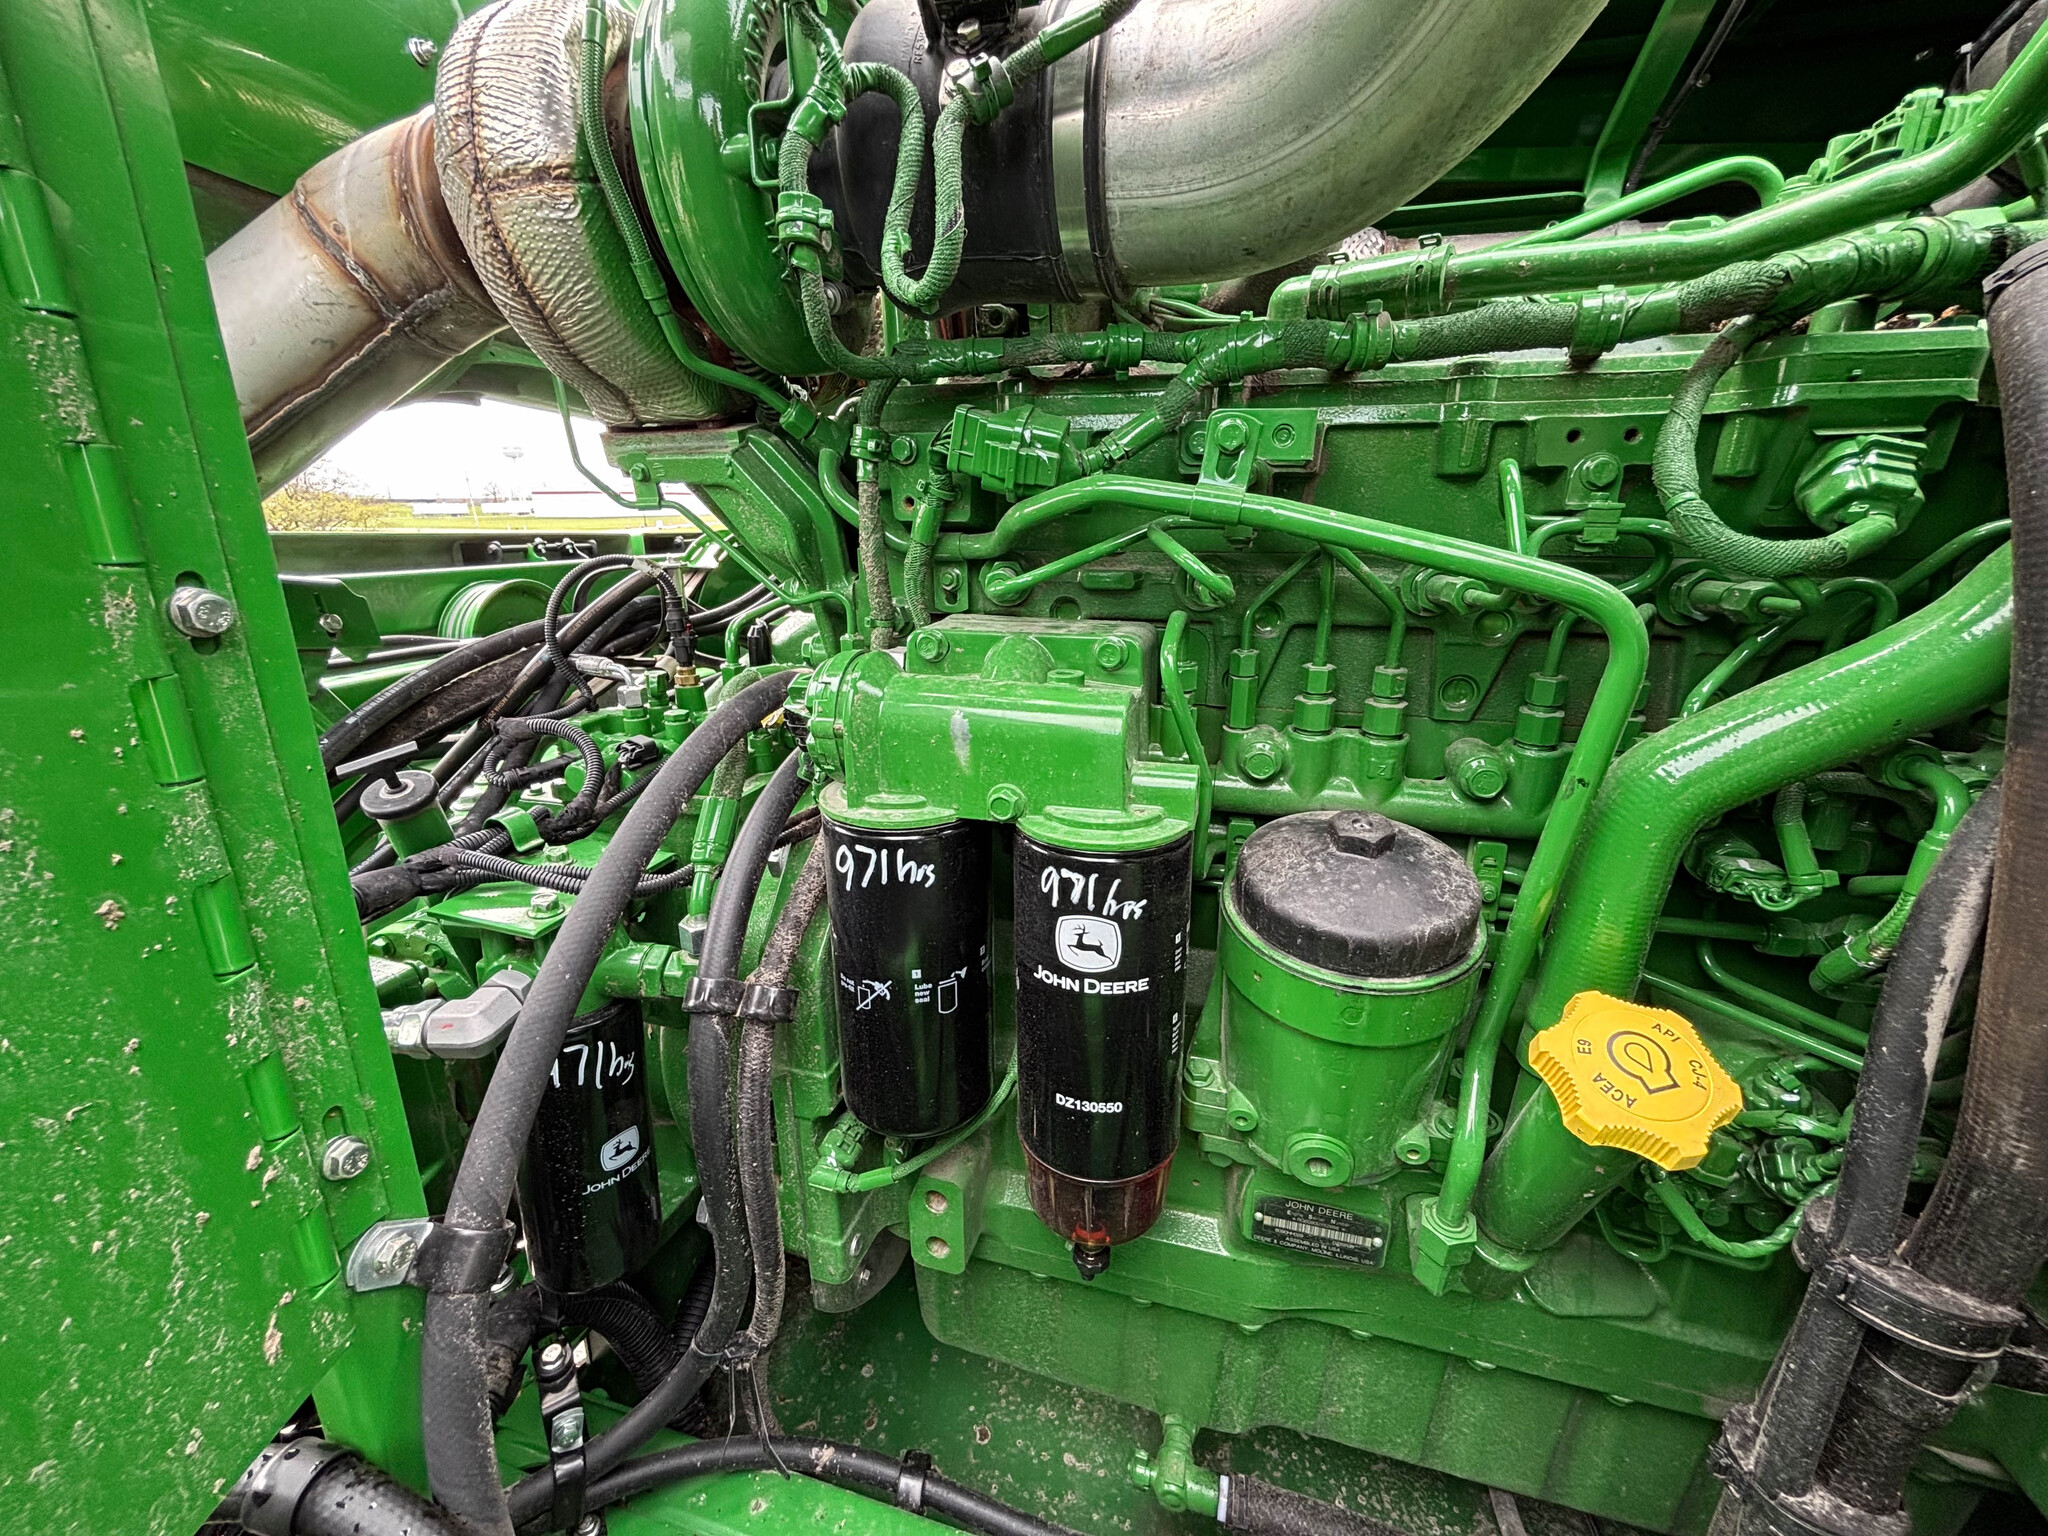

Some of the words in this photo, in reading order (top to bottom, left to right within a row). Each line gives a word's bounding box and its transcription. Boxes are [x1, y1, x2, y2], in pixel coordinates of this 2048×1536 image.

[835, 844, 889, 891] 971
[896, 848, 936, 888] hrs
[1041, 865, 1099, 911] 971
[914, 983, 933, 991] Lube
[1033, 964, 1080, 992] JOHN
[1083, 977, 1150, 995] DEERE
[1576, 1038, 1593, 1055] E9
[1651, 1023, 1682, 1043] API
[1688, 1058, 1708, 1091] CJ-4
[1592, 1071, 1638, 1109] ACEA
[1055, 1092, 1123, 1114] DZ130550
[582, 1173, 621, 1196] JOHN
[1285, 1200, 1314, 1213] JOHN
[1318, 1205, 1353, 1220] DEERE
[1253, 1234, 1272, 1243] DEERE
[1285, 1236, 1320, 1248] ASSEMBLED
